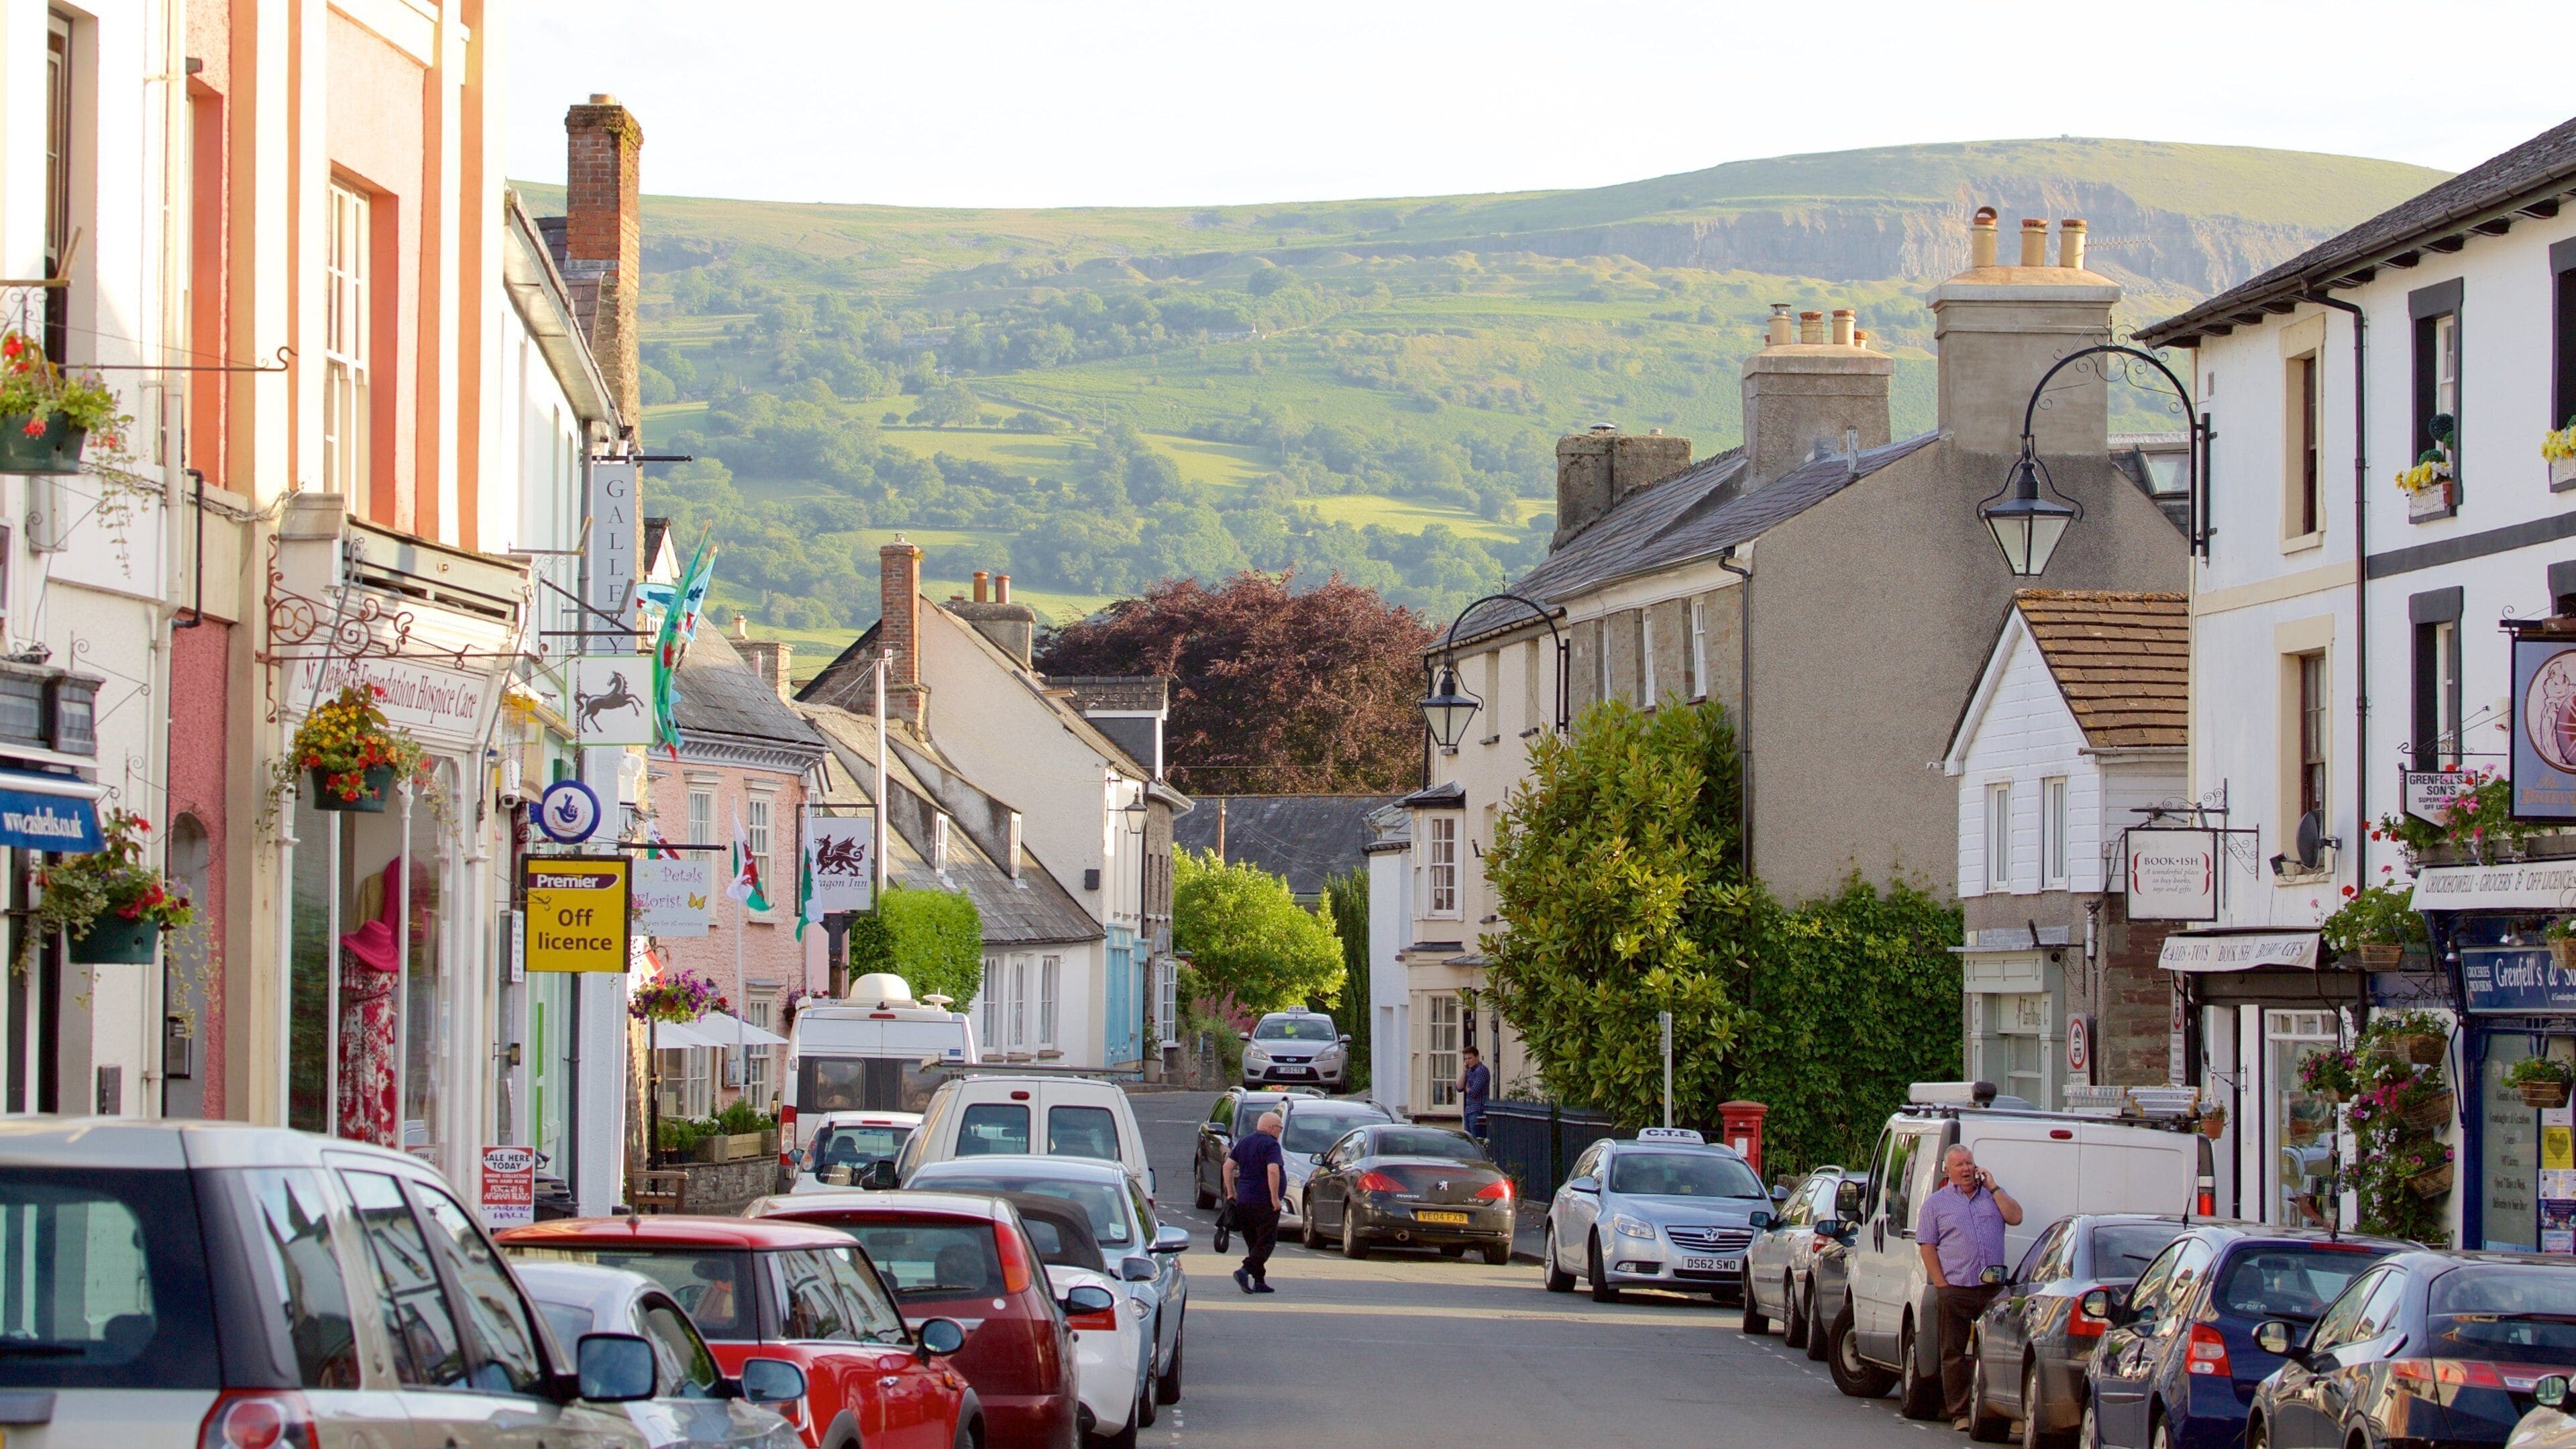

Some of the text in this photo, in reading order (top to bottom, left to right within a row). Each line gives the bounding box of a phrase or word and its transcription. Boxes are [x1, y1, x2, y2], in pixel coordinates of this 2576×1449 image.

[606, 480, 626, 655] GALLERY
[302, 652, 315, 691] St.
[360, 663, 416, 708] Foundation
[415, 675, 455, 724] Hospice
[455, 683, 478, 718] Care
[2410, 775, 2463, 785] GRENFEL'S
[2426, 786, 2456, 795] SON'S
[661, 866, 703, 883] Petals
[2152, 868, 2183, 877] wonderful
[2184, 869, 2200, 877] place
[537, 874, 598, 888] Premier
[849, 879, 867, 887] Inn
[2425, 874, 2475, 894] CRICKHOWELL
[2479, 873, 2513, 892] GROCERS
[2179, 885, 2191, 894] gifts
[637, 892, 682, 908] Florist
[558, 908, 594, 926] Off
[538, 932, 612, 950] licence
[2190, 945, 2210, 961] TOYS
[2496, 957, 2542, 996] Grenfell's
[2548, 959, 2558, 986] &
[1646, 1129, 1697, 1138] C.T.E.
[492, 1162, 521, 1170] TODAY
[484, 1192, 530, 1201] AFGHAN RUGS
[1422, 1212, 1464, 1222] VE04 FXB
[1687, 1258, 1736, 1270] DS62 SWO
